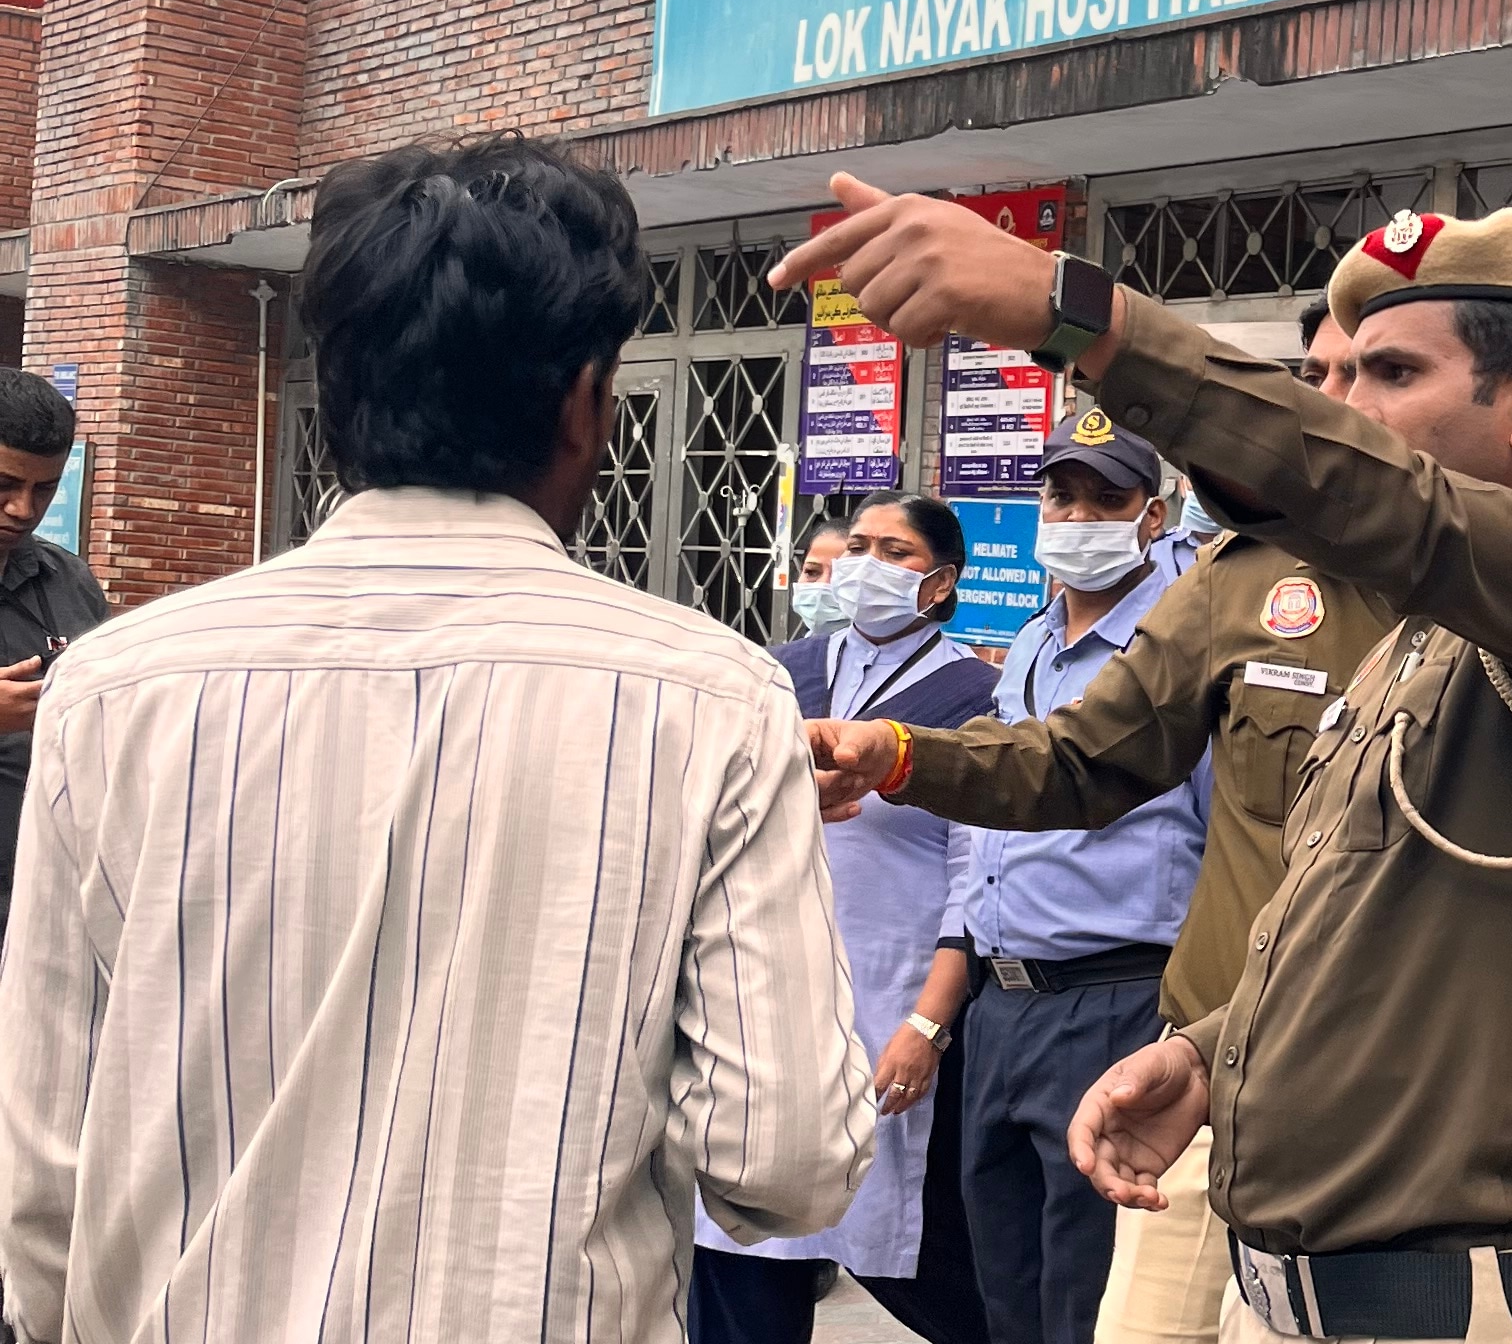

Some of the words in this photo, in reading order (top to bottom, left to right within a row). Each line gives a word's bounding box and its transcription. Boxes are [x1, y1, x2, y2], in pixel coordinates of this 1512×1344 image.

[793, 6, 871, 84] LOK
[973, 541, 1018, 559] HELMATE
[981, 566, 1026, 583] ALLOWED
[1027, 569, 1041, 585] IN
[956, 588, 1005, 606] ERGENCY
[1006, 592, 1039, 609] BLOCK
[1260, 667, 1290, 678] VIKRAM
